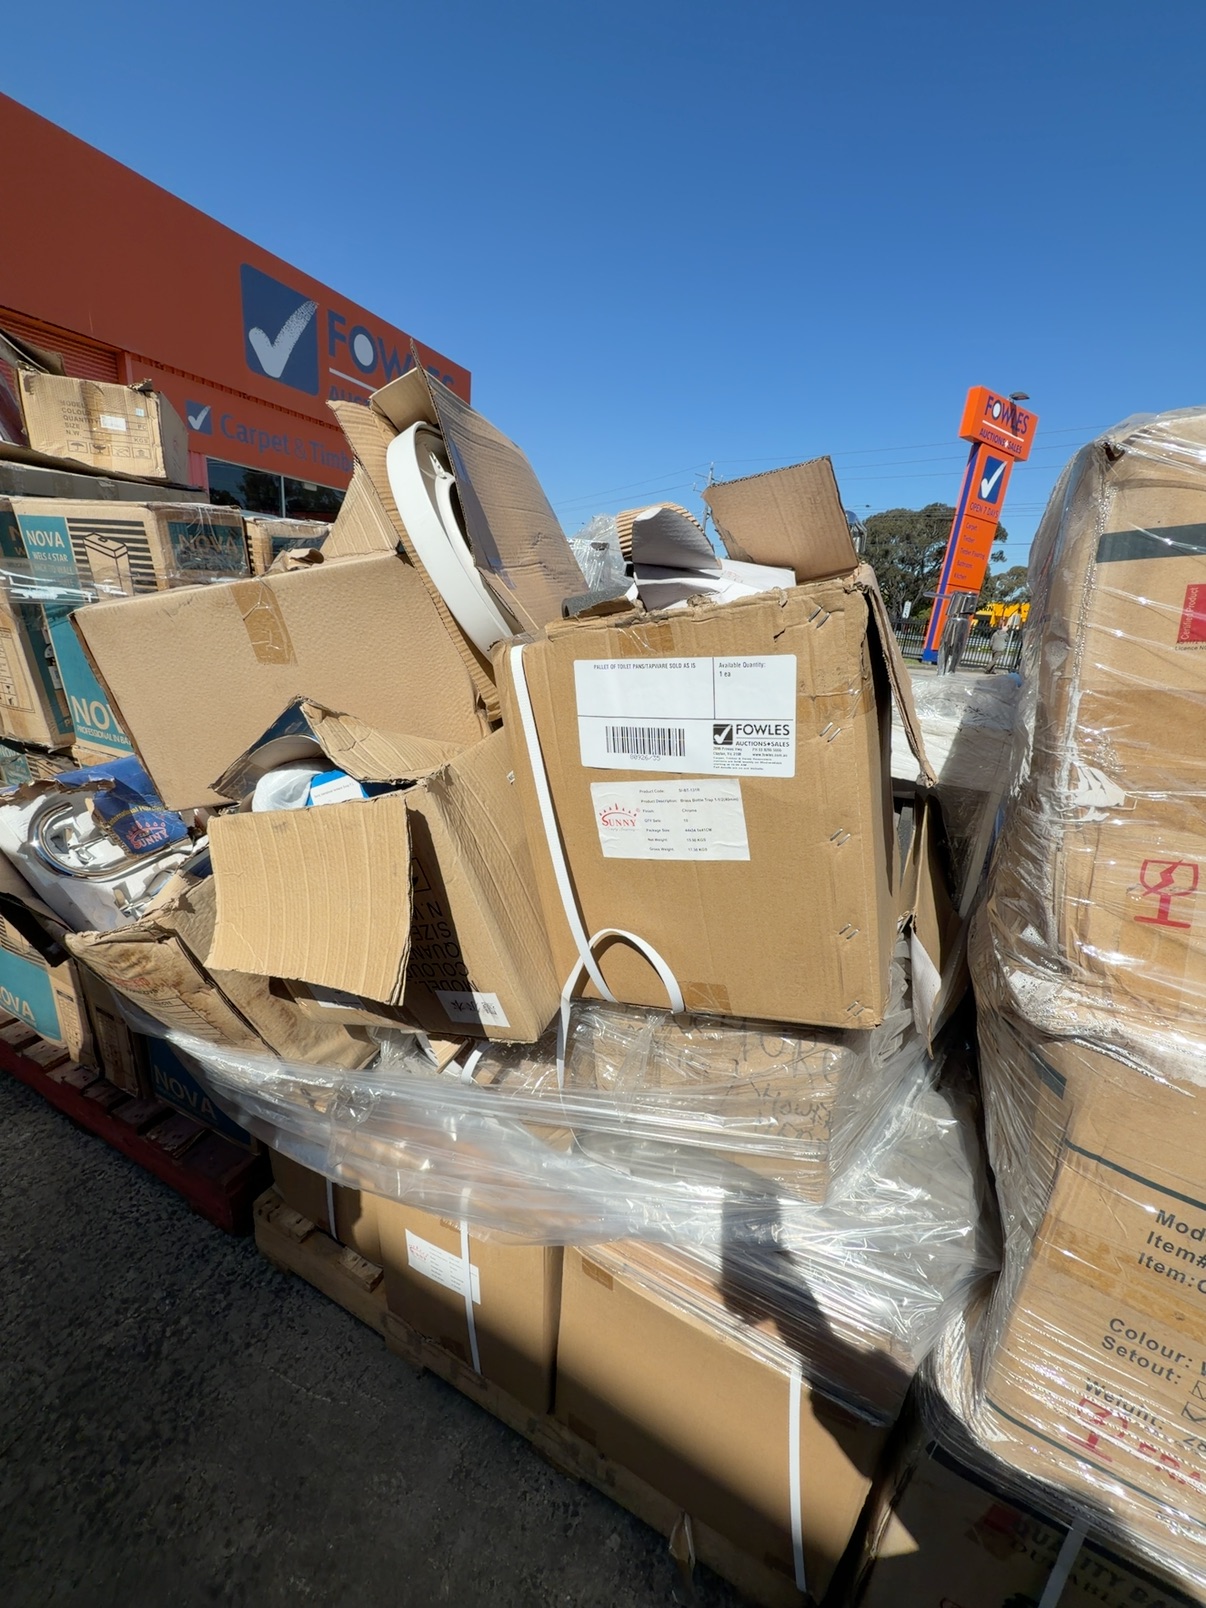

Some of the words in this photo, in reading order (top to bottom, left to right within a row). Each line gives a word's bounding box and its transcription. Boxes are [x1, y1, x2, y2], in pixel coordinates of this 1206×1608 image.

[327, 308, 454, 384] FOW
[984, 395, 1030, 435] FOWLES
[219, 413, 290, 455] Carpet
[294, 439, 307, 461] &
[970, 502, 983, 513] OPEN
[988, 508, 999, 518] DAYS
[26, 529, 65, 548] NOVA
[178, 534, 239, 554] NOVA
[32, 551, 48, 561] WELS
[52, 552, 68, 562] STAR
[1185, 586, 1199, 613] Product
[1181, 613, 1194, 640] Certified
[742, 661, 766, 669] Quantity:
[77, 725, 112, 741] PROFESSIONAL
[736, 724, 790, 736] FOWLES
[602, 811, 636, 827] SUNNY
[131, 828, 169, 849] SUNNY
[153, 1064, 218, 1120] NOVA
[1109, 1317, 1193, 1369] Colour:
[1101, 1335, 1181, 1385] Setout:
